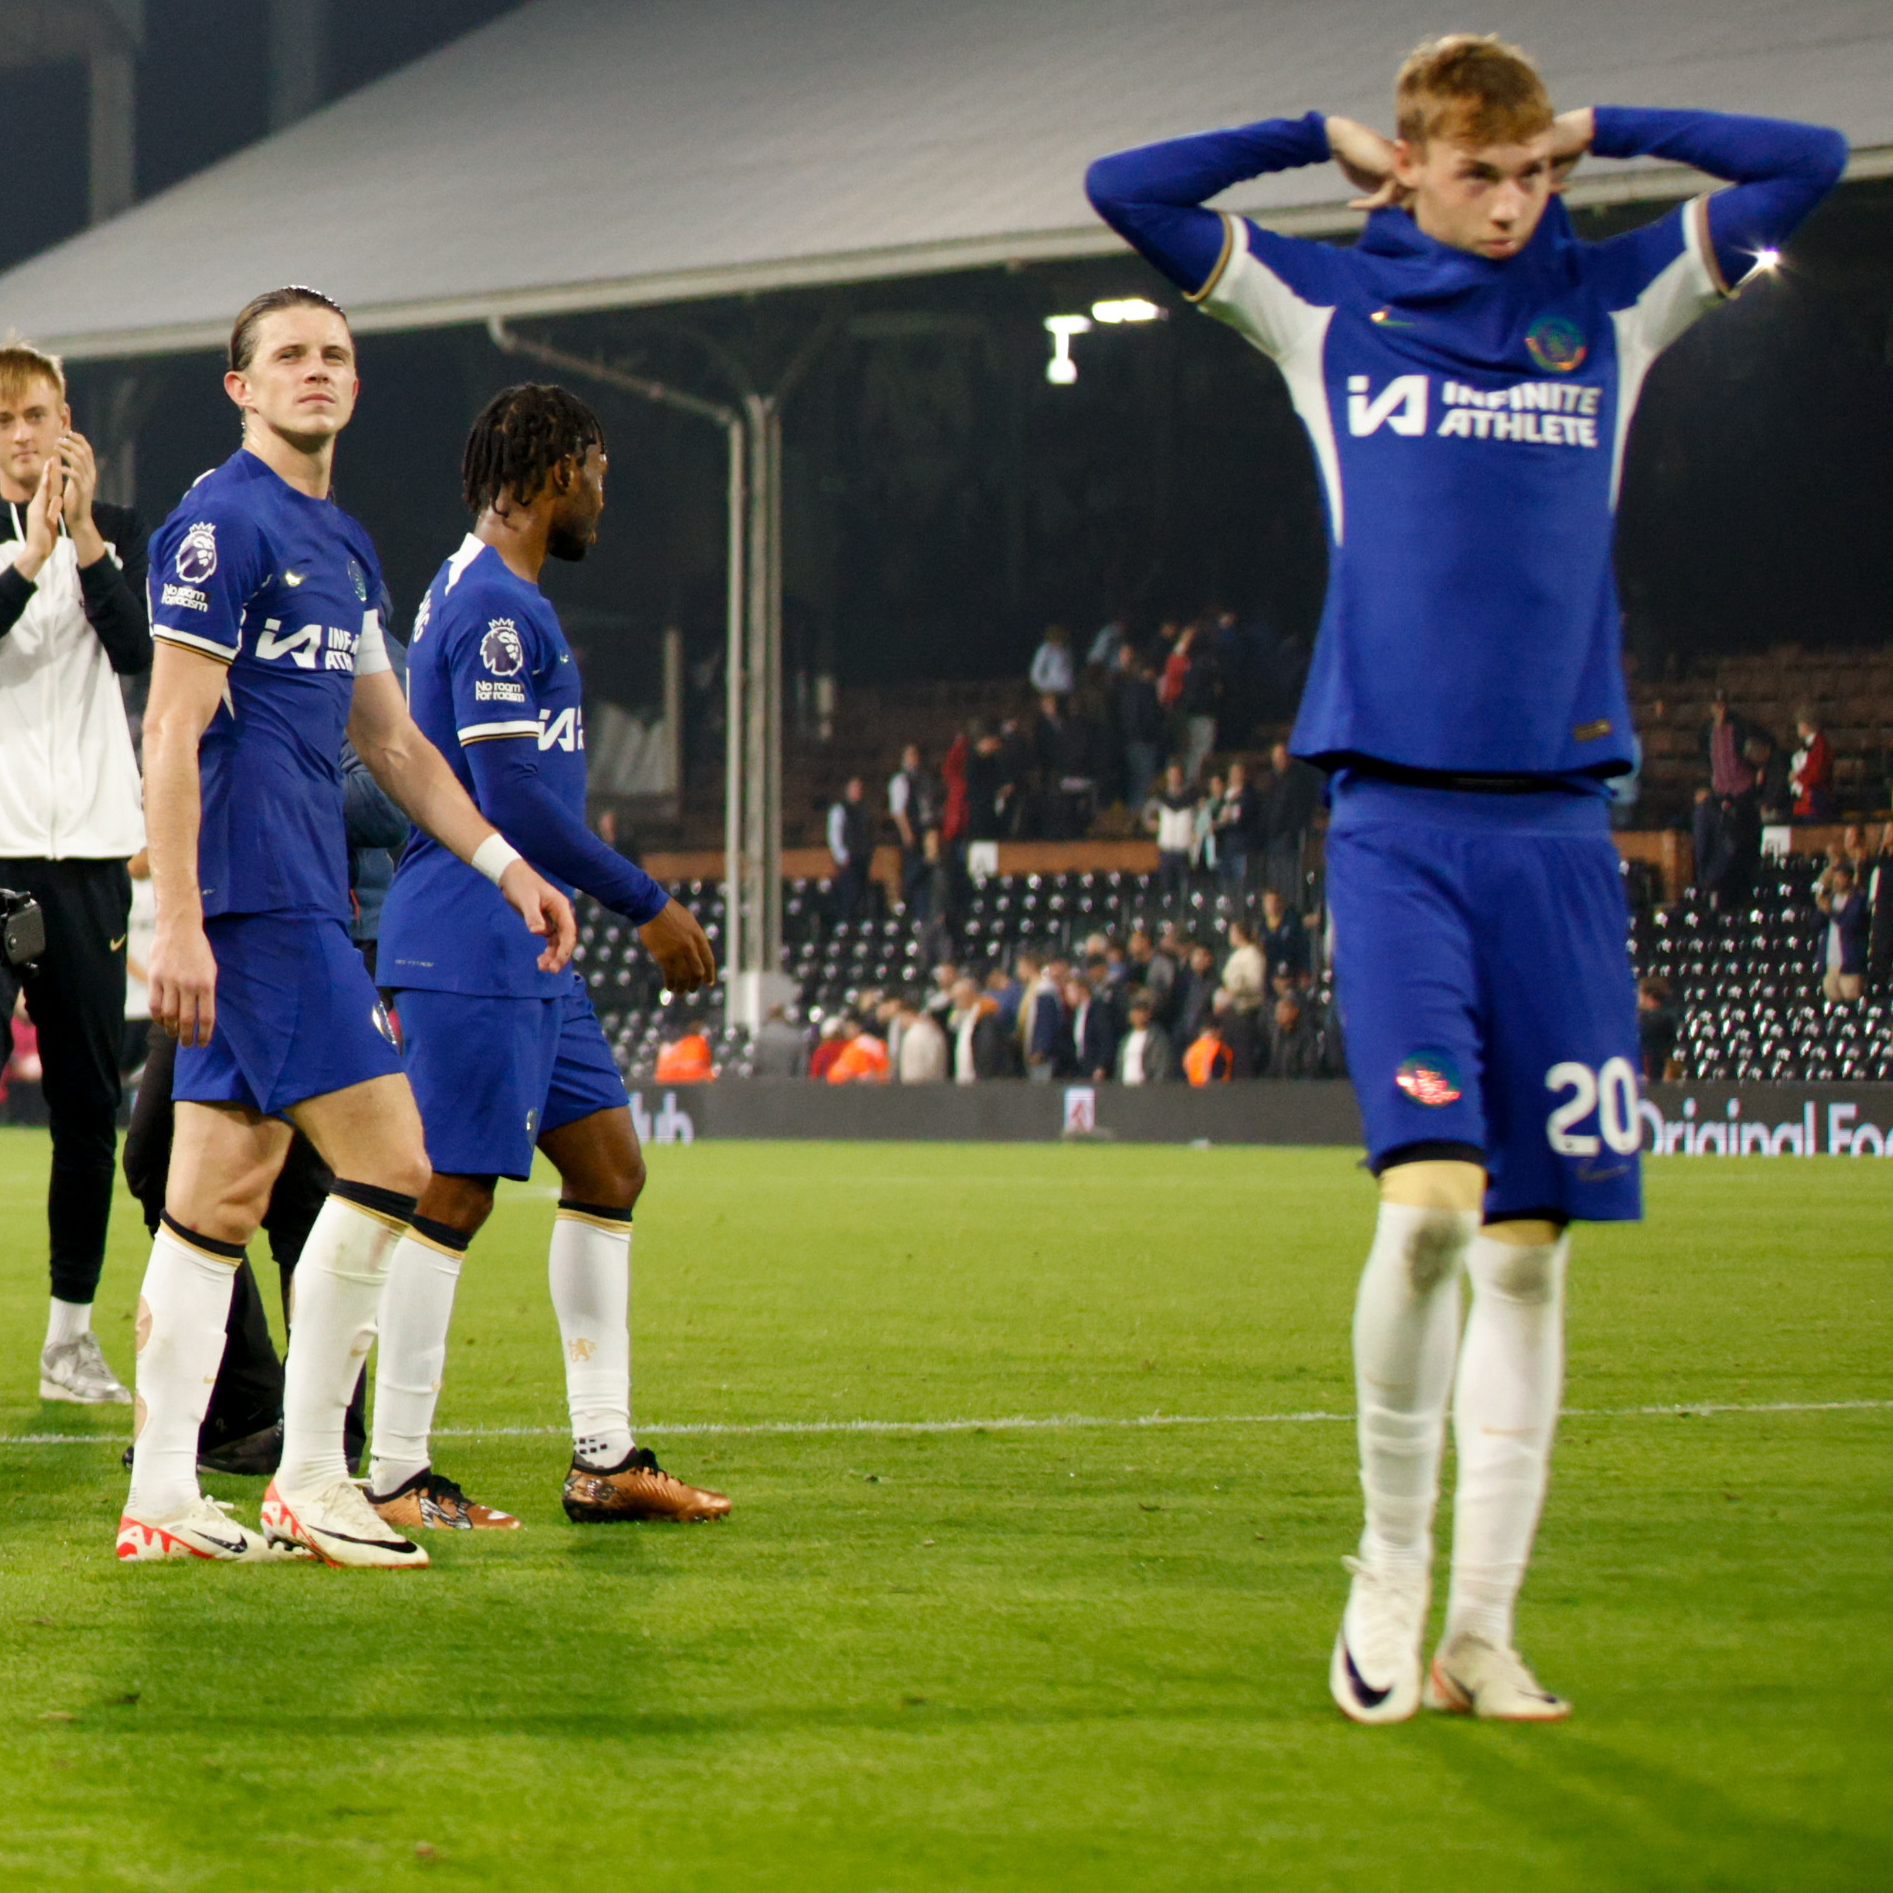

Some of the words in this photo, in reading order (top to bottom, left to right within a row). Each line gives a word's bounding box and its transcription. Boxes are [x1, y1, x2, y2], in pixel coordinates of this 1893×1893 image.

[1442, 380, 1603, 416] INFINITE
[1436, 407, 1599, 449] ATHLETE
[475, 680, 492, 692] No
[493, 681, 521, 693] room
[493, 691, 525, 703] racism
[1545, 1056, 1643, 1156] 20
